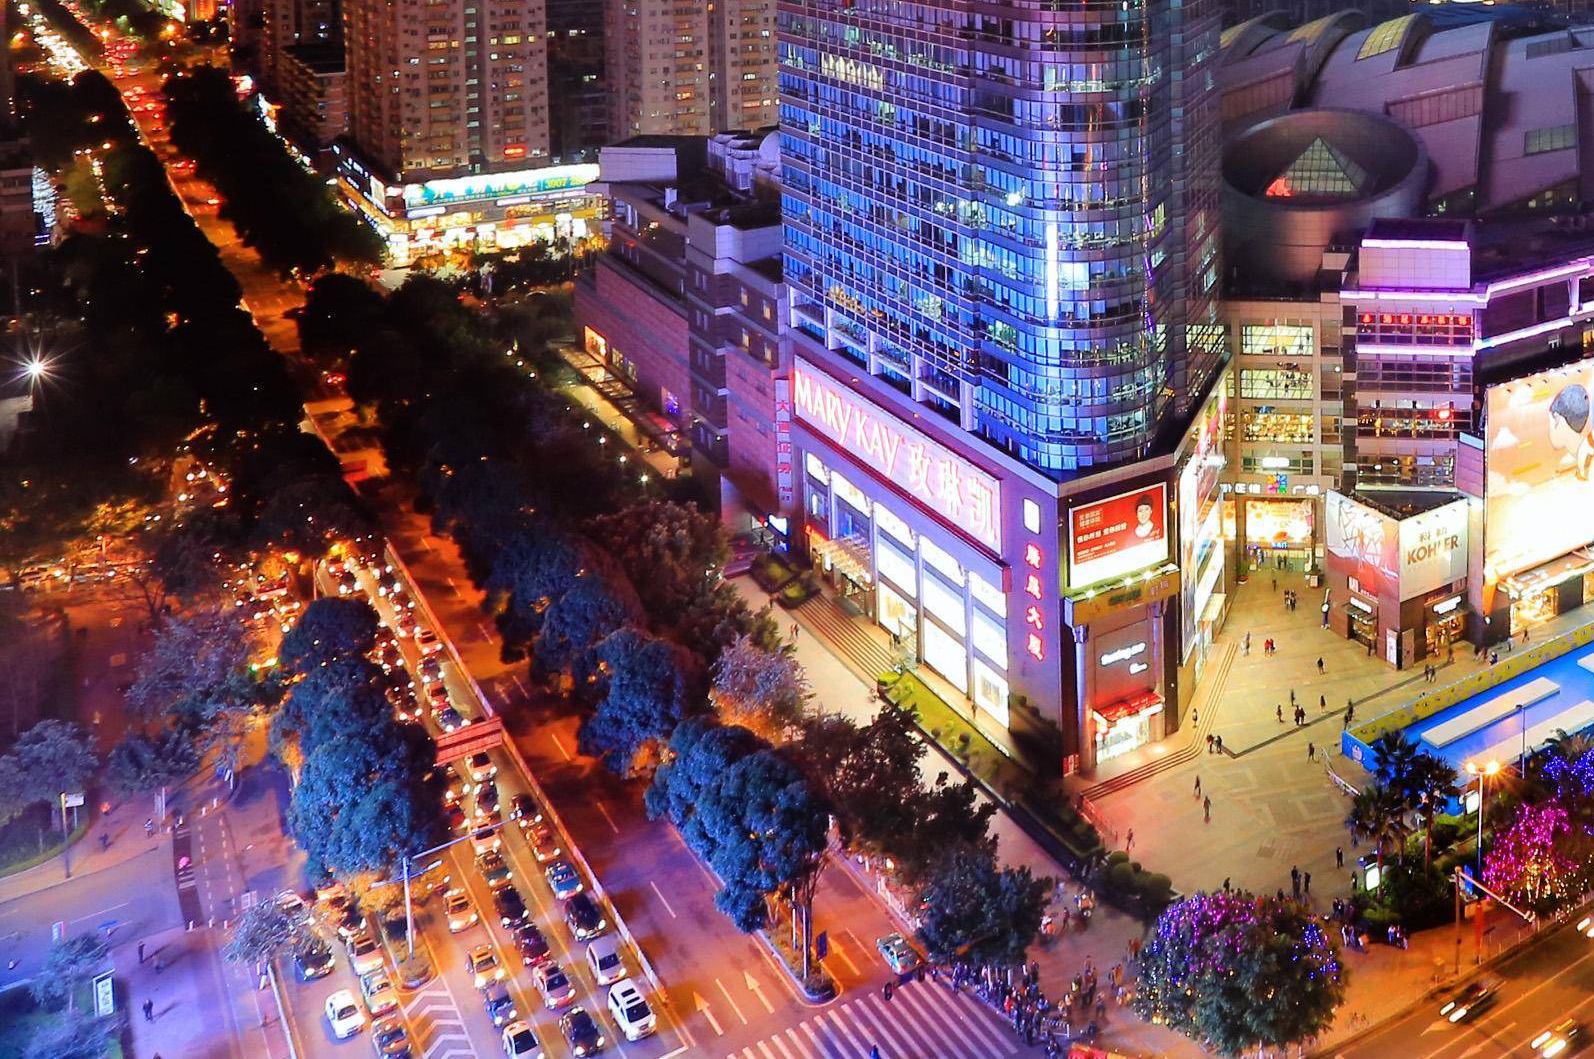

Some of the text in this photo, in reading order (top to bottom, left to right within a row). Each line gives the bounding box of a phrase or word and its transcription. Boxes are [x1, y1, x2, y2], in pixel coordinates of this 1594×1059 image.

[794, 369, 853, 445] MARY
[855, 409, 902, 479] KAY
[907, 444, 998, 544] 玫琳凯
